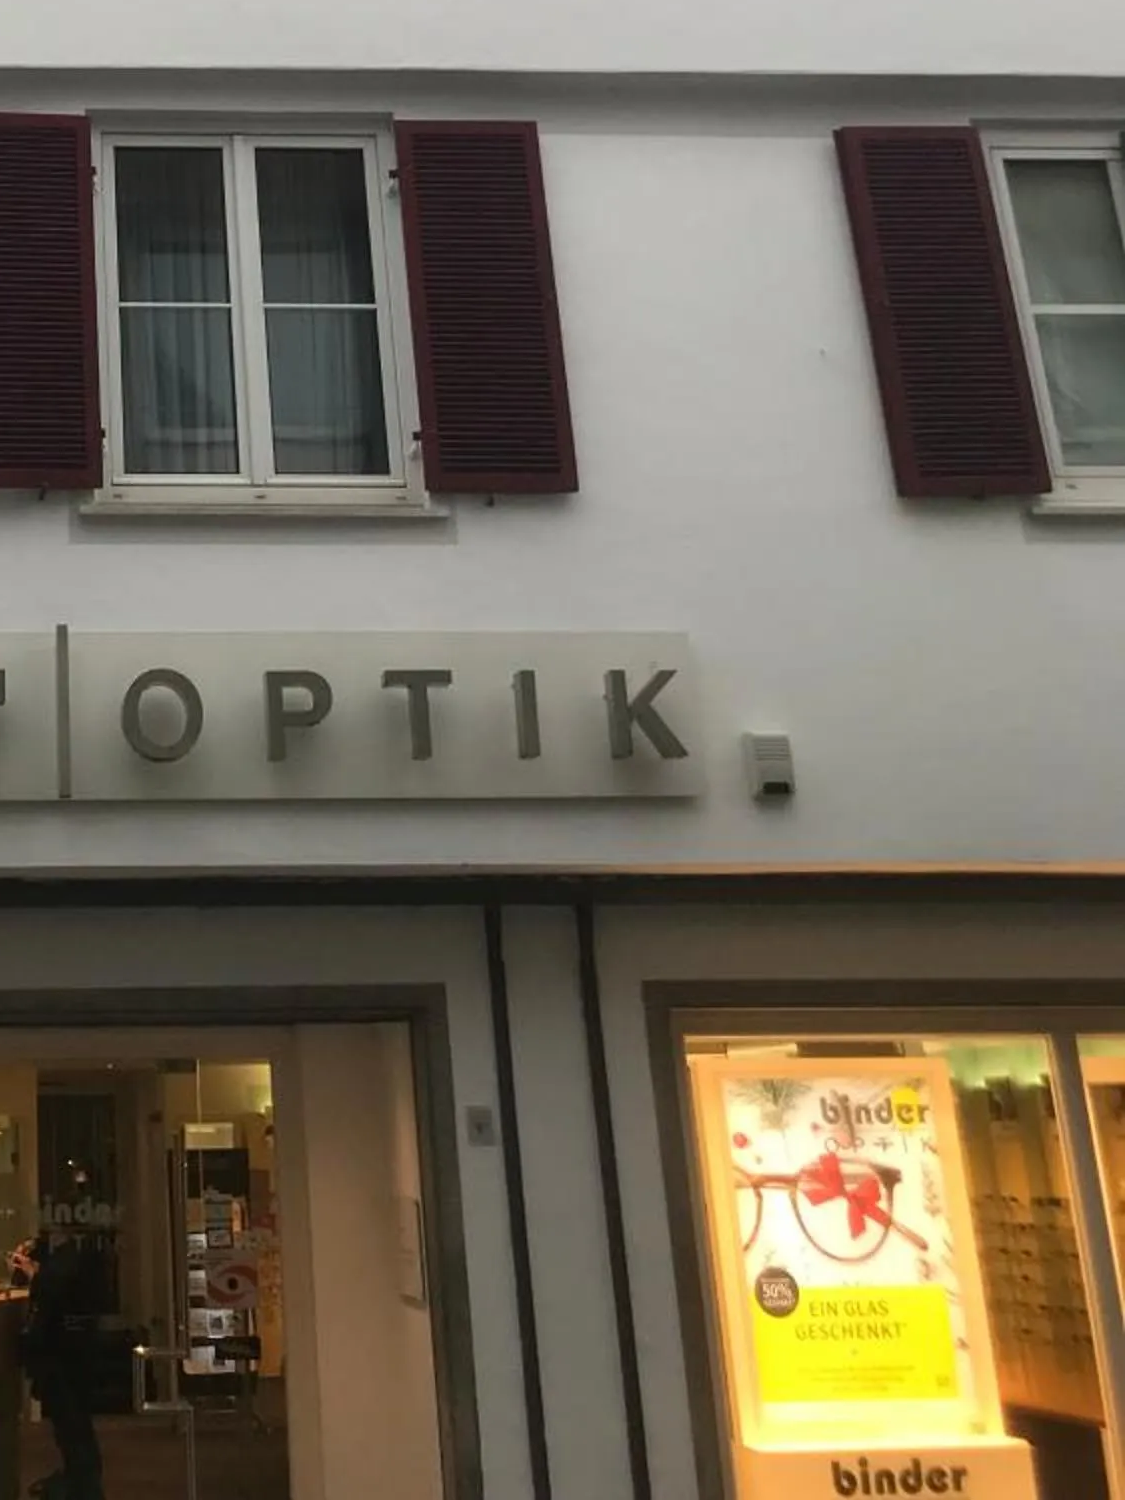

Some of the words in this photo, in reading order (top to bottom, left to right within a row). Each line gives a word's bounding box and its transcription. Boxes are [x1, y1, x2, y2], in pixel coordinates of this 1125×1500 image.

[121, 668, 689, 763] OPTIK
[819, 1093, 930, 1125] binder
[809, 1301, 839, 1318] EIN
[843, 1300, 890, 1318] GLAS
[831, 1456, 969, 1498] binder
